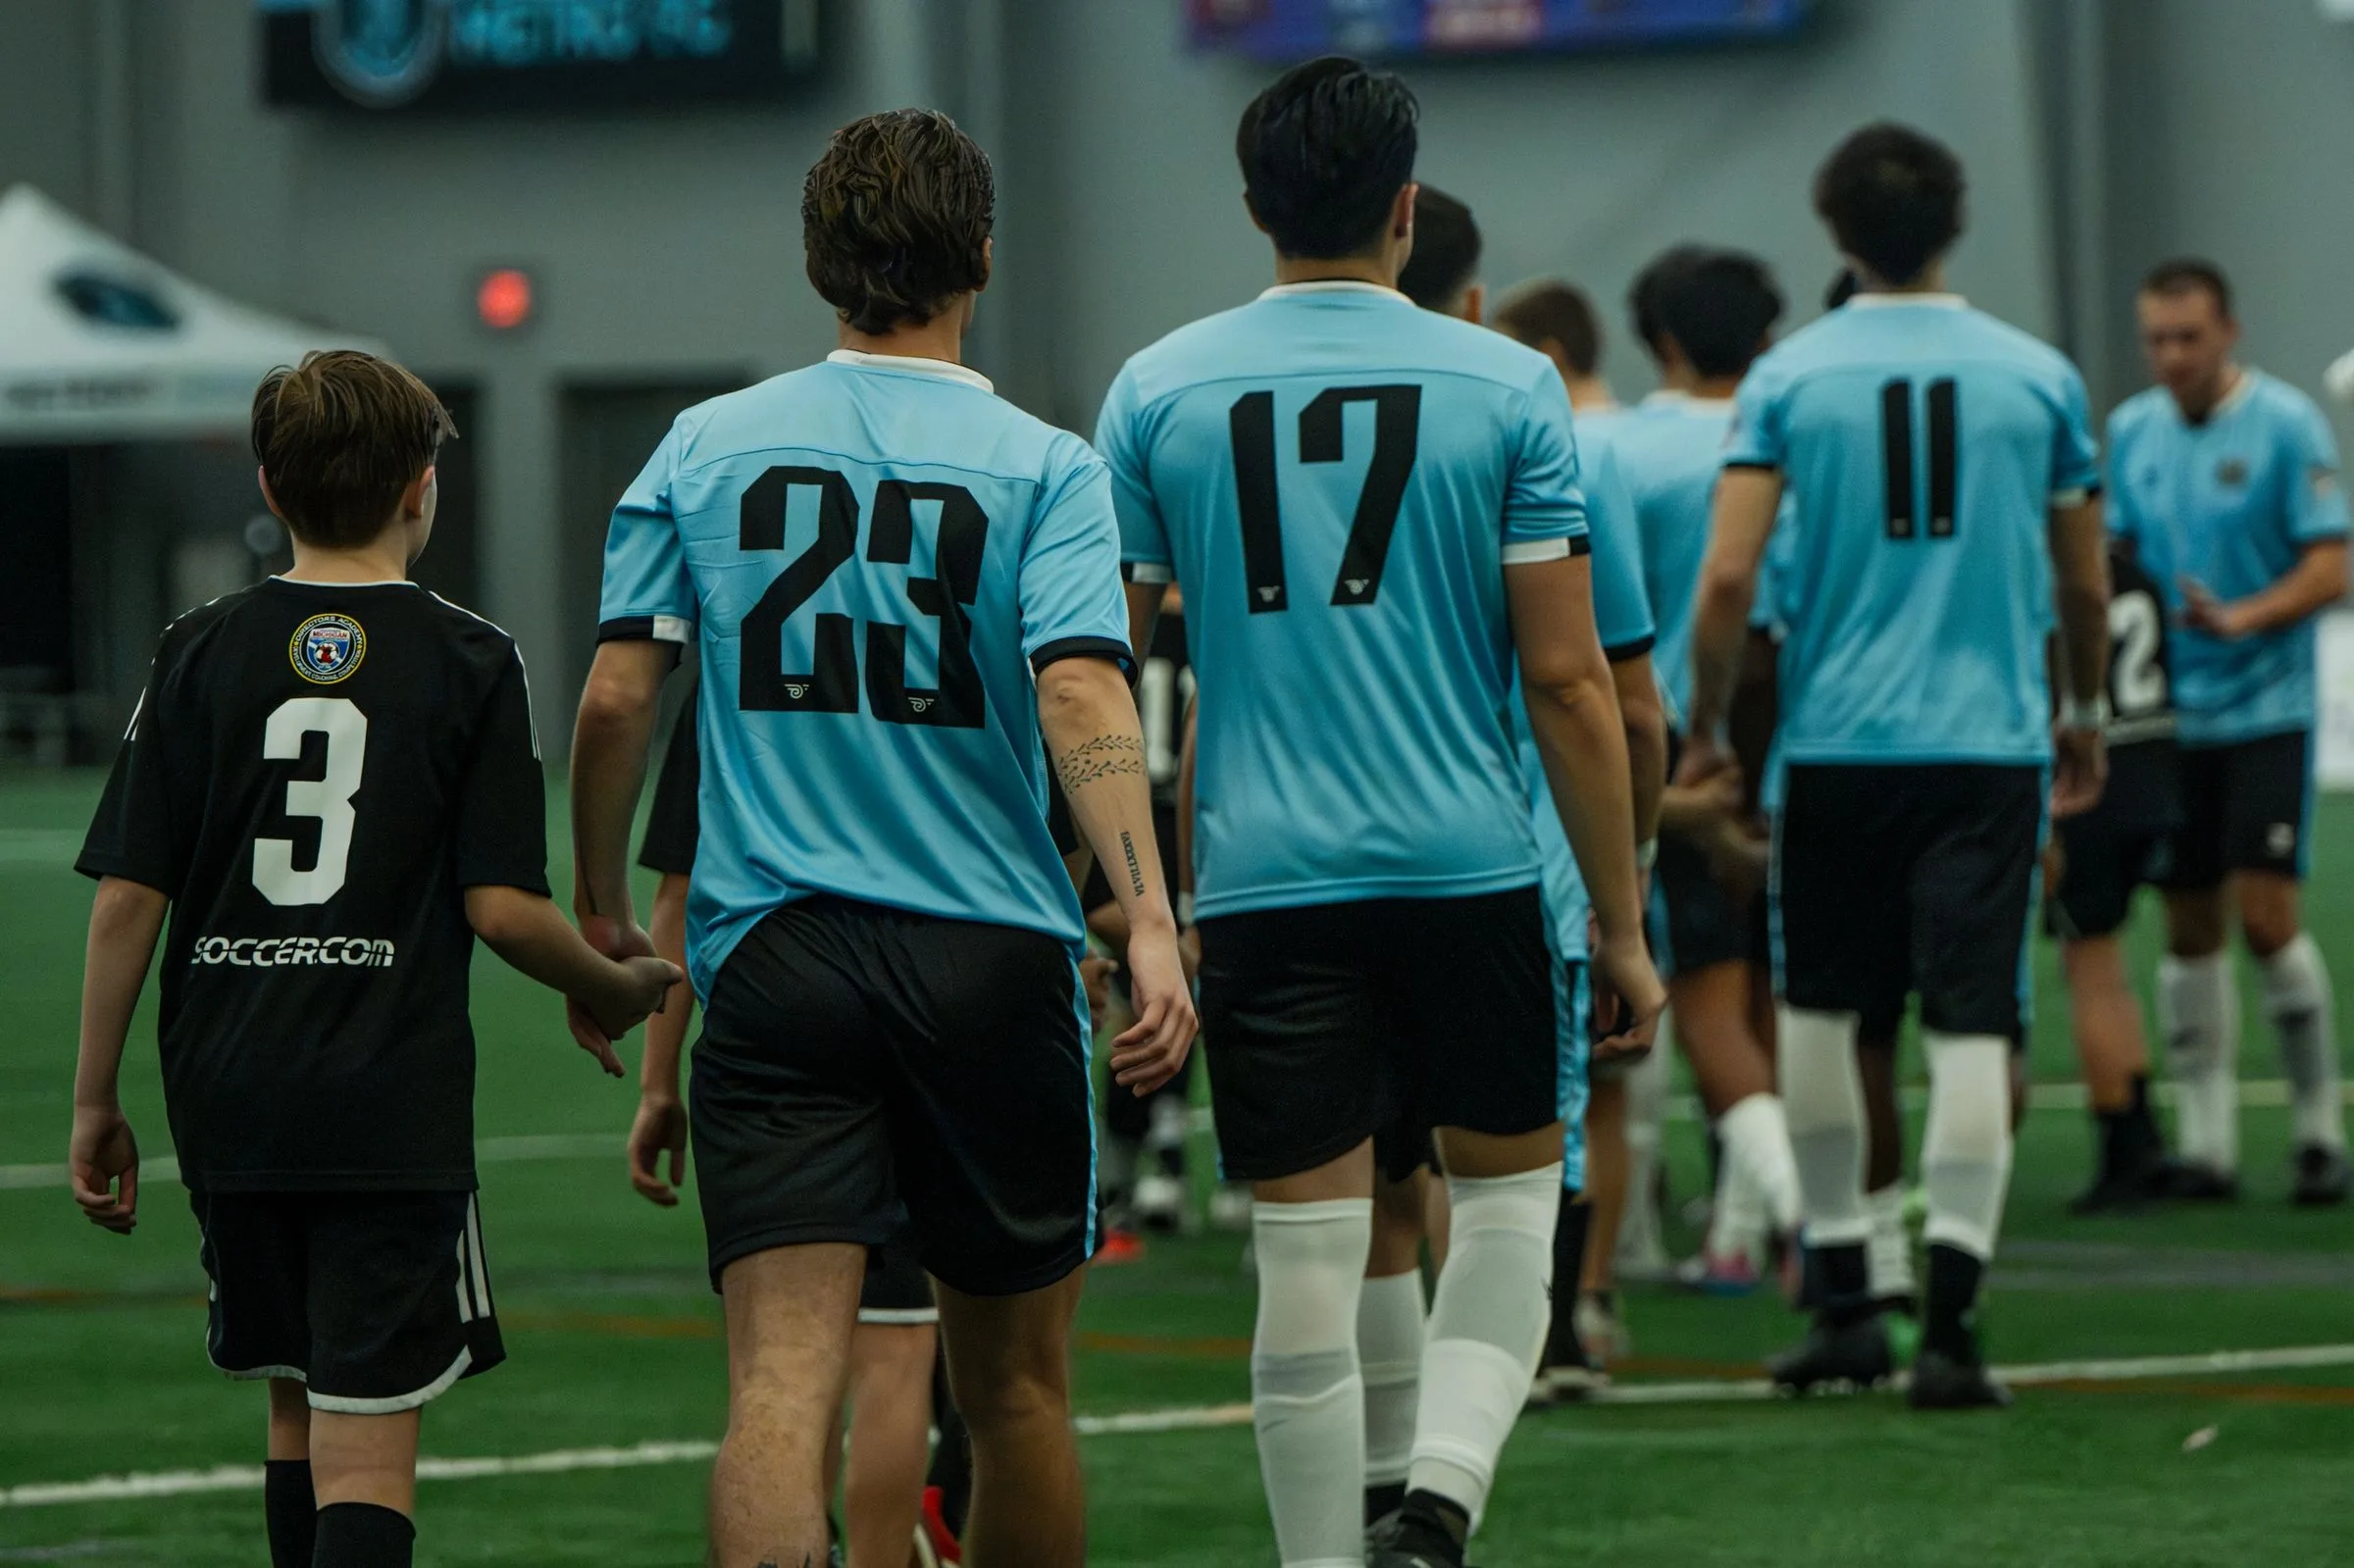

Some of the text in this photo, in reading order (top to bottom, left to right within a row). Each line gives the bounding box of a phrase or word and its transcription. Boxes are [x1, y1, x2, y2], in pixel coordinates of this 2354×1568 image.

[1230, 383, 1422, 614] 17
[1881, 377, 1958, 538] 11
[295, 616, 363, 644] DIRECTORS ACADEMY
[740, 466, 989, 729] 23
[252, 697, 368, 906] 3
